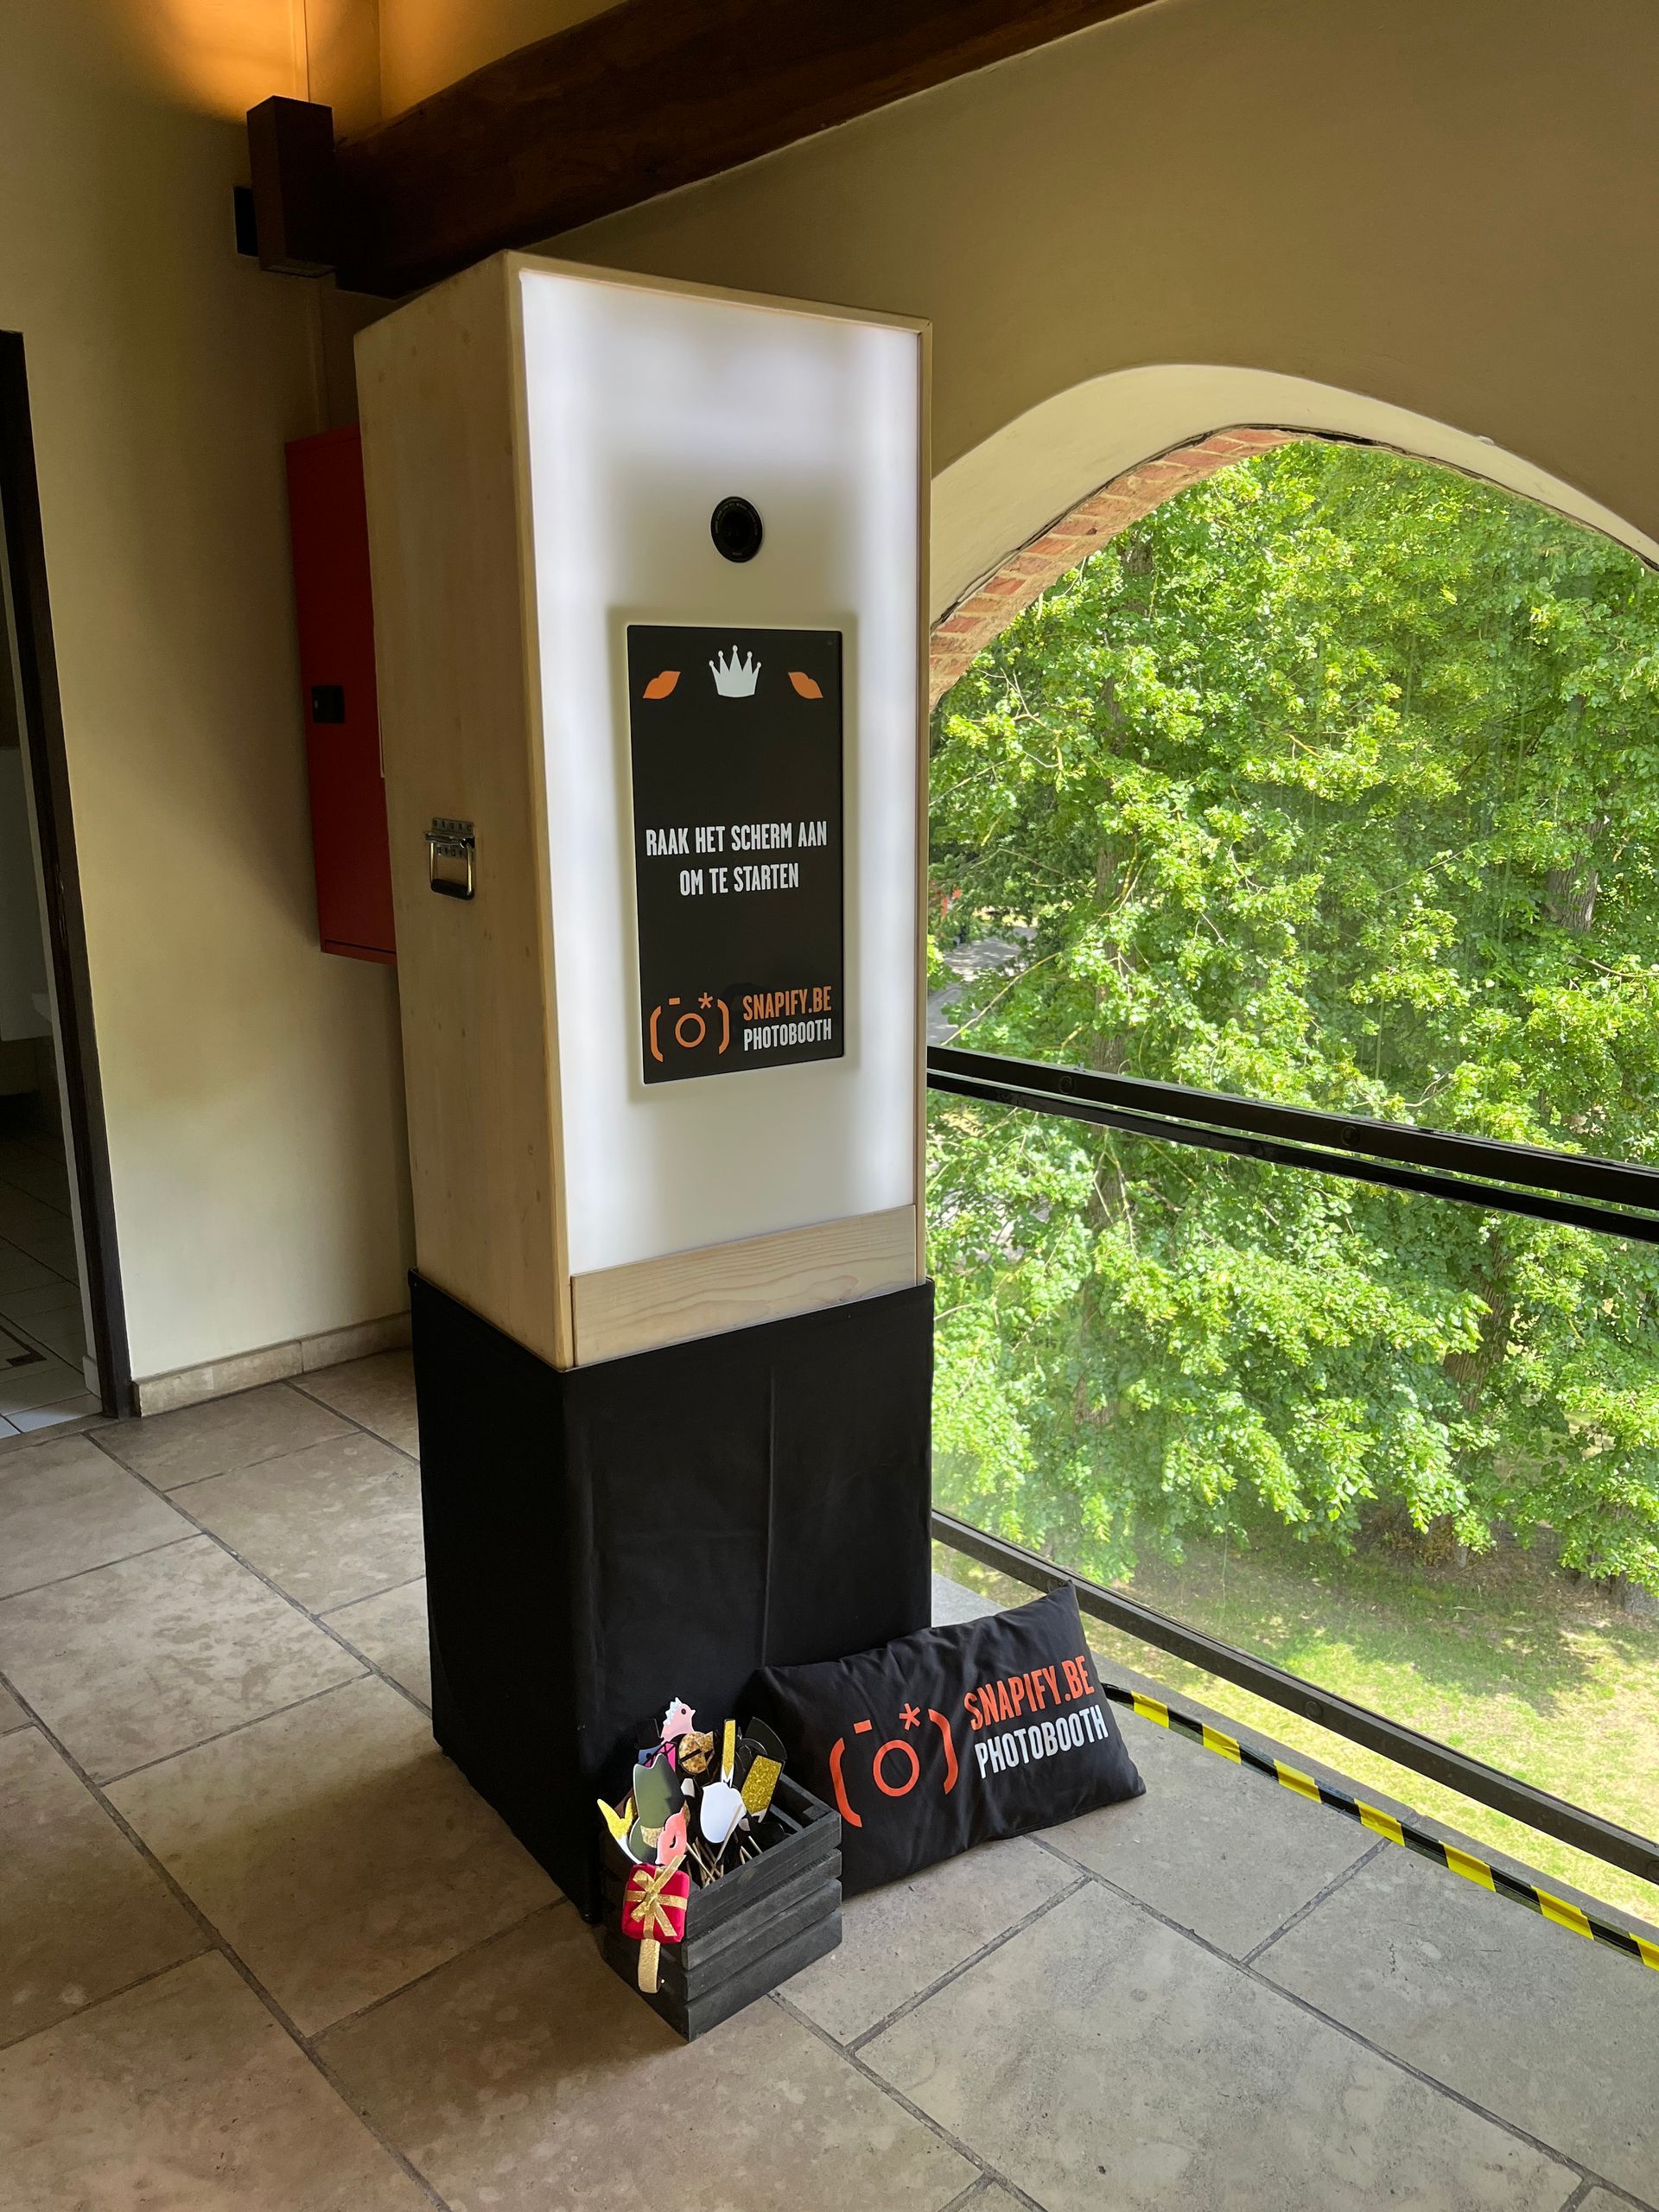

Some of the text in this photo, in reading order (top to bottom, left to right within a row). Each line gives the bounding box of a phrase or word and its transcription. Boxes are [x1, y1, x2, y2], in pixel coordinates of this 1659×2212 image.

[646, 821, 828, 856] RAAK HET SCHERM AAN
[679, 862, 799, 896] OM TE STARTEN
[742, 986, 832, 1022] SNAPIFY.BE
[743, 1018, 832, 1052] PHOTOBOOTH
[963, 1655, 1095, 1731] SNAPIFY.BE
[974, 1704, 1109, 1780] PHOTOBOOTH
